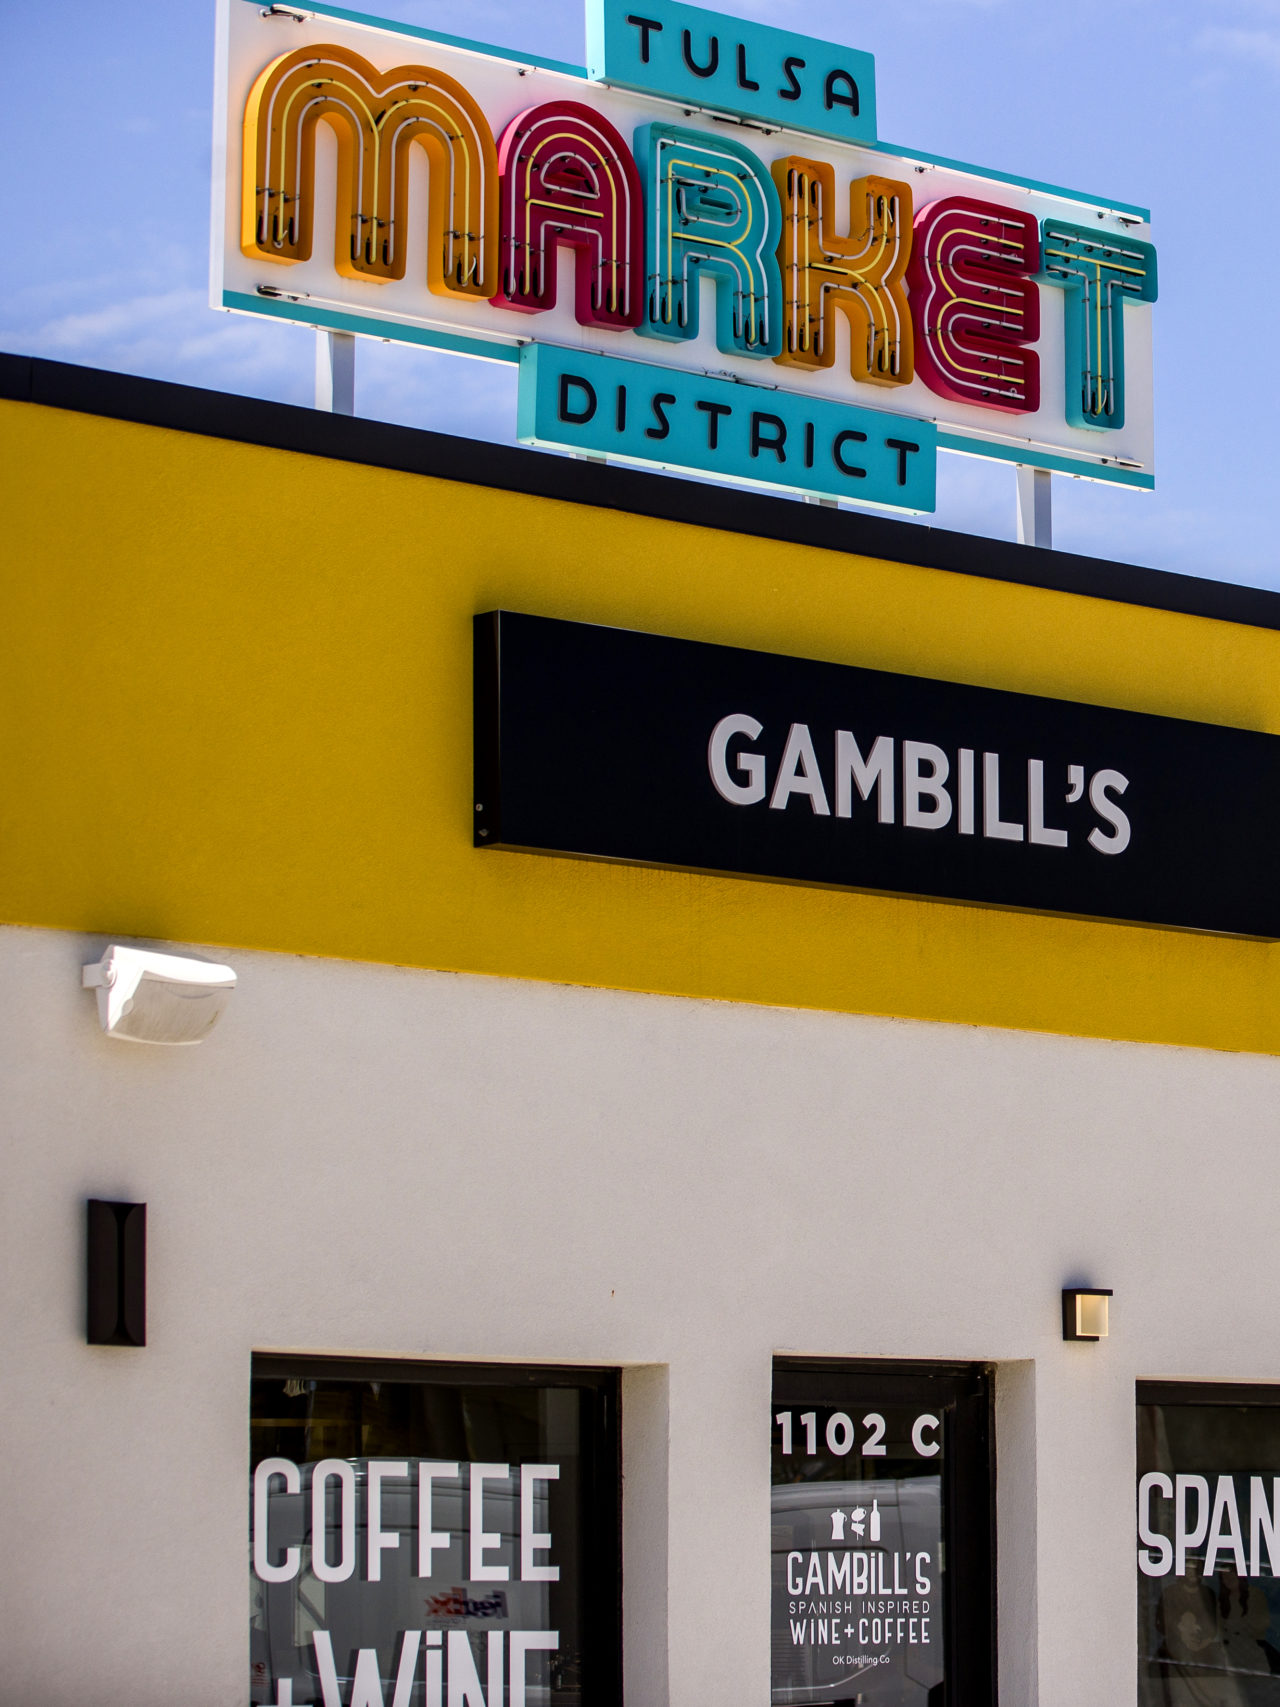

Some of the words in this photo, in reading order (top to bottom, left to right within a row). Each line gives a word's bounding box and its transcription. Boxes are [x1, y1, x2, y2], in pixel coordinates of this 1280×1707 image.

[625, 14, 862, 119] TULSA
[240, 43, 1158, 433] MARKET
[557, 372, 920, 487] DISTRICT
[707, 713, 1132, 856] GAMBILL'S
[775, 1411, 887, 1456] 1102
[911, 1414, 941, 1457] C
[253, 1458, 560, 1583] COFFEE
[788, 1600, 852, 1614] SPANISH
[862, 1601, 930, 1614] INSPIRED
[832, 1656, 845, 1665] OK
[846, 1655, 877, 1666] Distilling
[879, 1655, 890, 1664] Co
